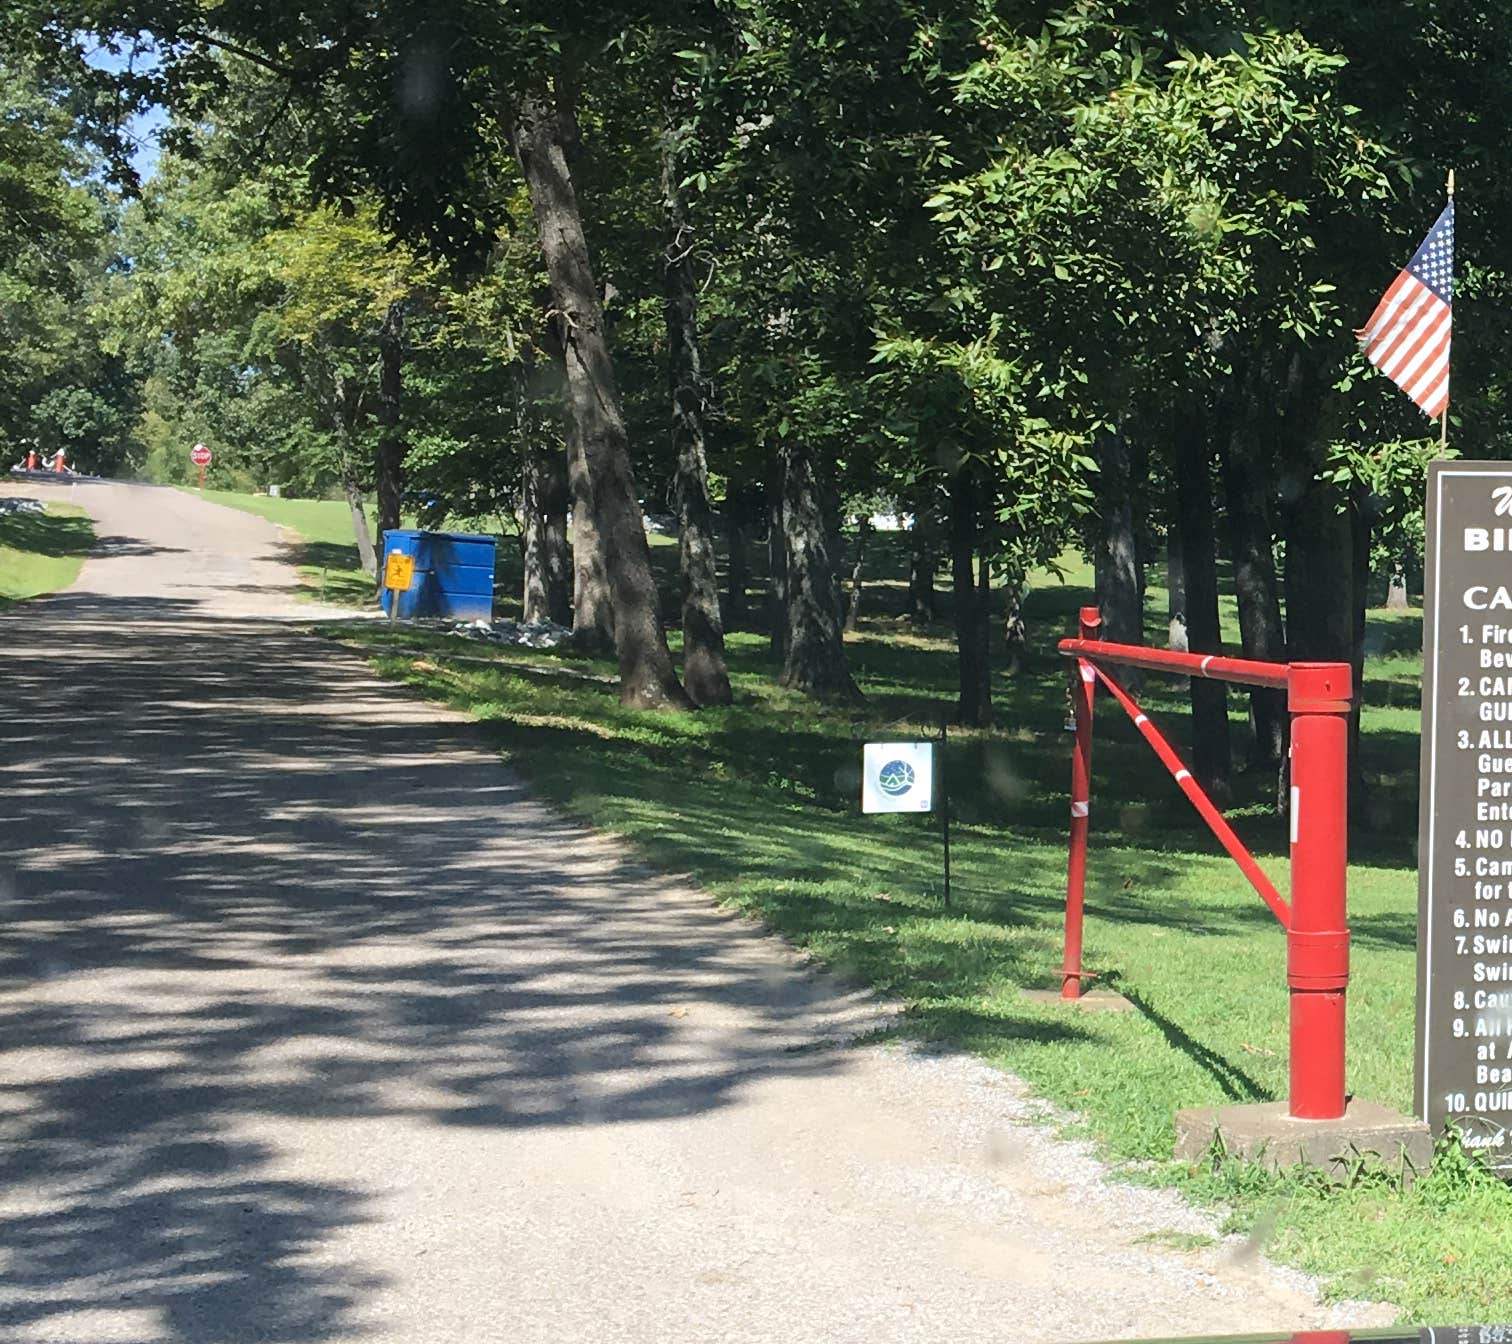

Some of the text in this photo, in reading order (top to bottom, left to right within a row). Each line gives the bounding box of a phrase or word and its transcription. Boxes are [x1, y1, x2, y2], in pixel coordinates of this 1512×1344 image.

[1459, 626, 1474, 644] 1.
[1458, 678, 1475, 696] 2.
[1458, 731, 1475, 749] 3.
[1455, 831, 1471, 848] 4.
[1476, 830, 1502, 848] NO
[1455, 858, 1471, 875] 5.
[1474, 882, 1502, 900] for
[1454, 910, 1469, 928] 6.
[1474, 908, 1499, 928] No
[1455, 936, 1469, 954] 7.
[1454, 992, 1469, 1010] 8.
[1453, 1018, 1469, 1037] 9.
[1478, 1041, 1495, 1060] at
[1445, 1094, 1469, 1113] 10.
[1460, 1127, 1505, 1148] hank
